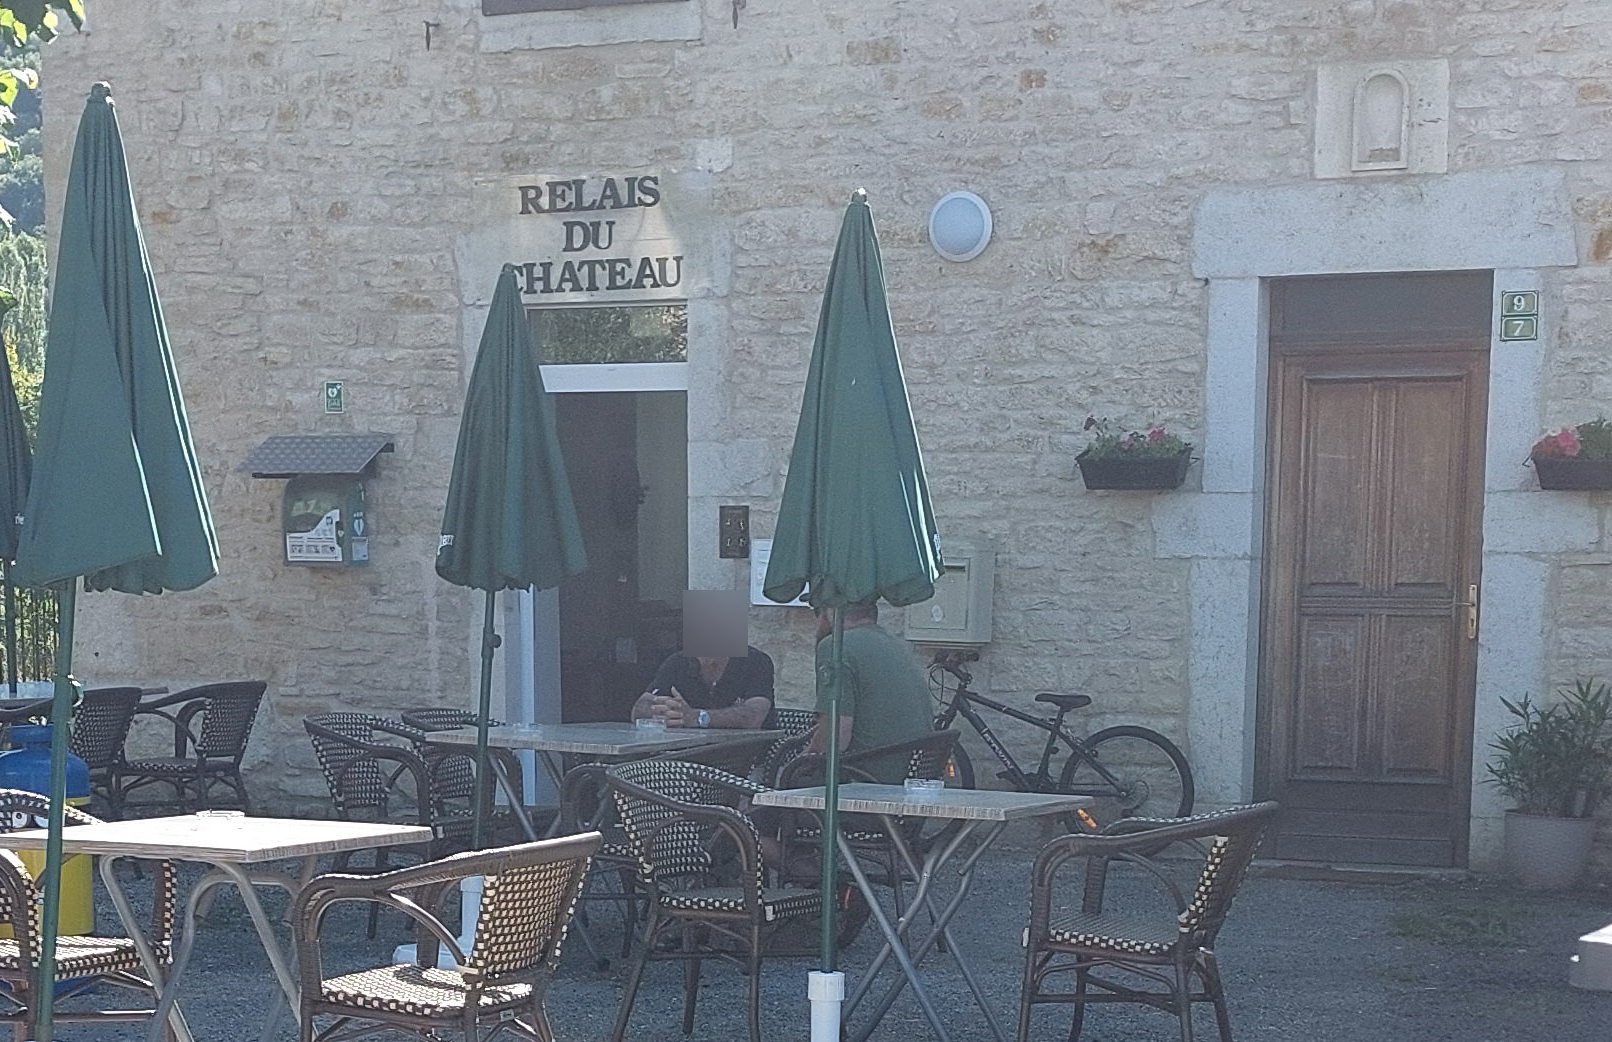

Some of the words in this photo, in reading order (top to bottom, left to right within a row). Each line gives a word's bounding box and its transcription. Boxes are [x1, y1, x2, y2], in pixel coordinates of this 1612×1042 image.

[518, 175, 661, 215] RELAIS
[562, 220, 617, 253] DU
[1513, 295, 1525, 311] 9
[1512, 320, 1525, 336] 7
